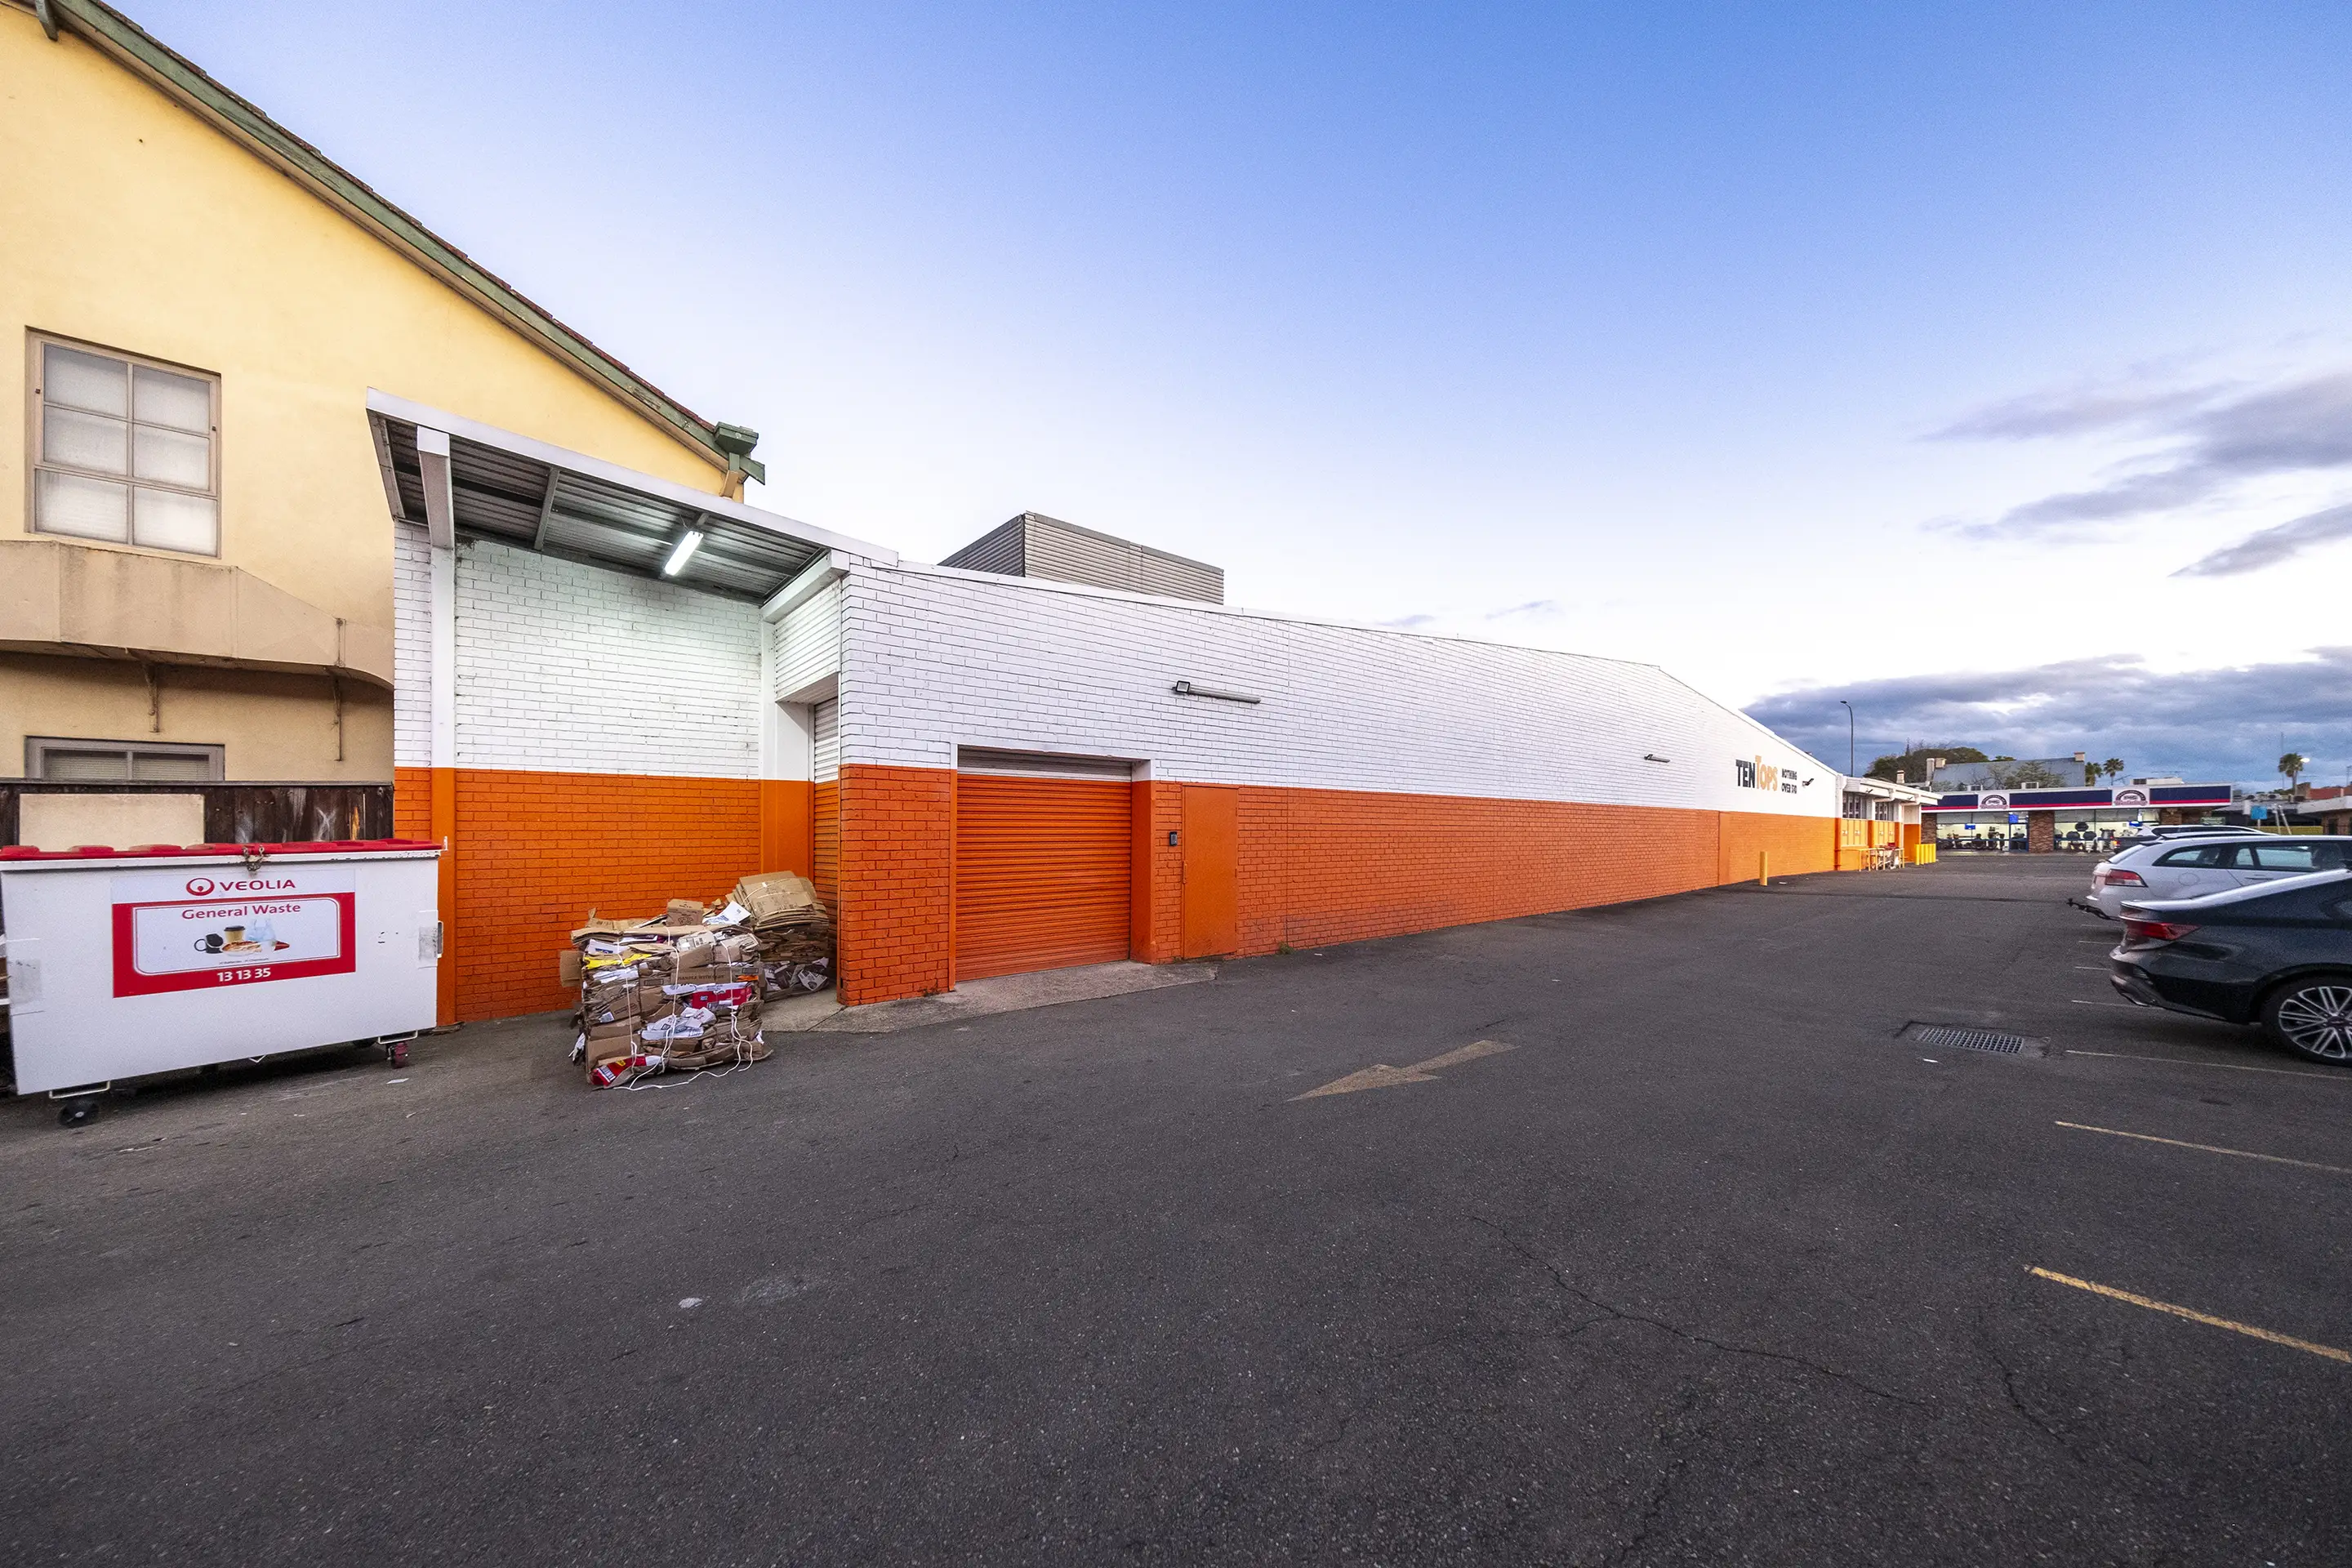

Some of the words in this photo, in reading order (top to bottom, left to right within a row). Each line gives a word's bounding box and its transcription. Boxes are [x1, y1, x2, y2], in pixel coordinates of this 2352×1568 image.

[219, 879, 296, 891] VEOLIA
[181, 906, 247, 920] General
[252, 903, 301, 915] Waste
[216, 971, 233, 982] 13
[236, 969, 252, 980] 13
[254, 967, 271, 978] 35
